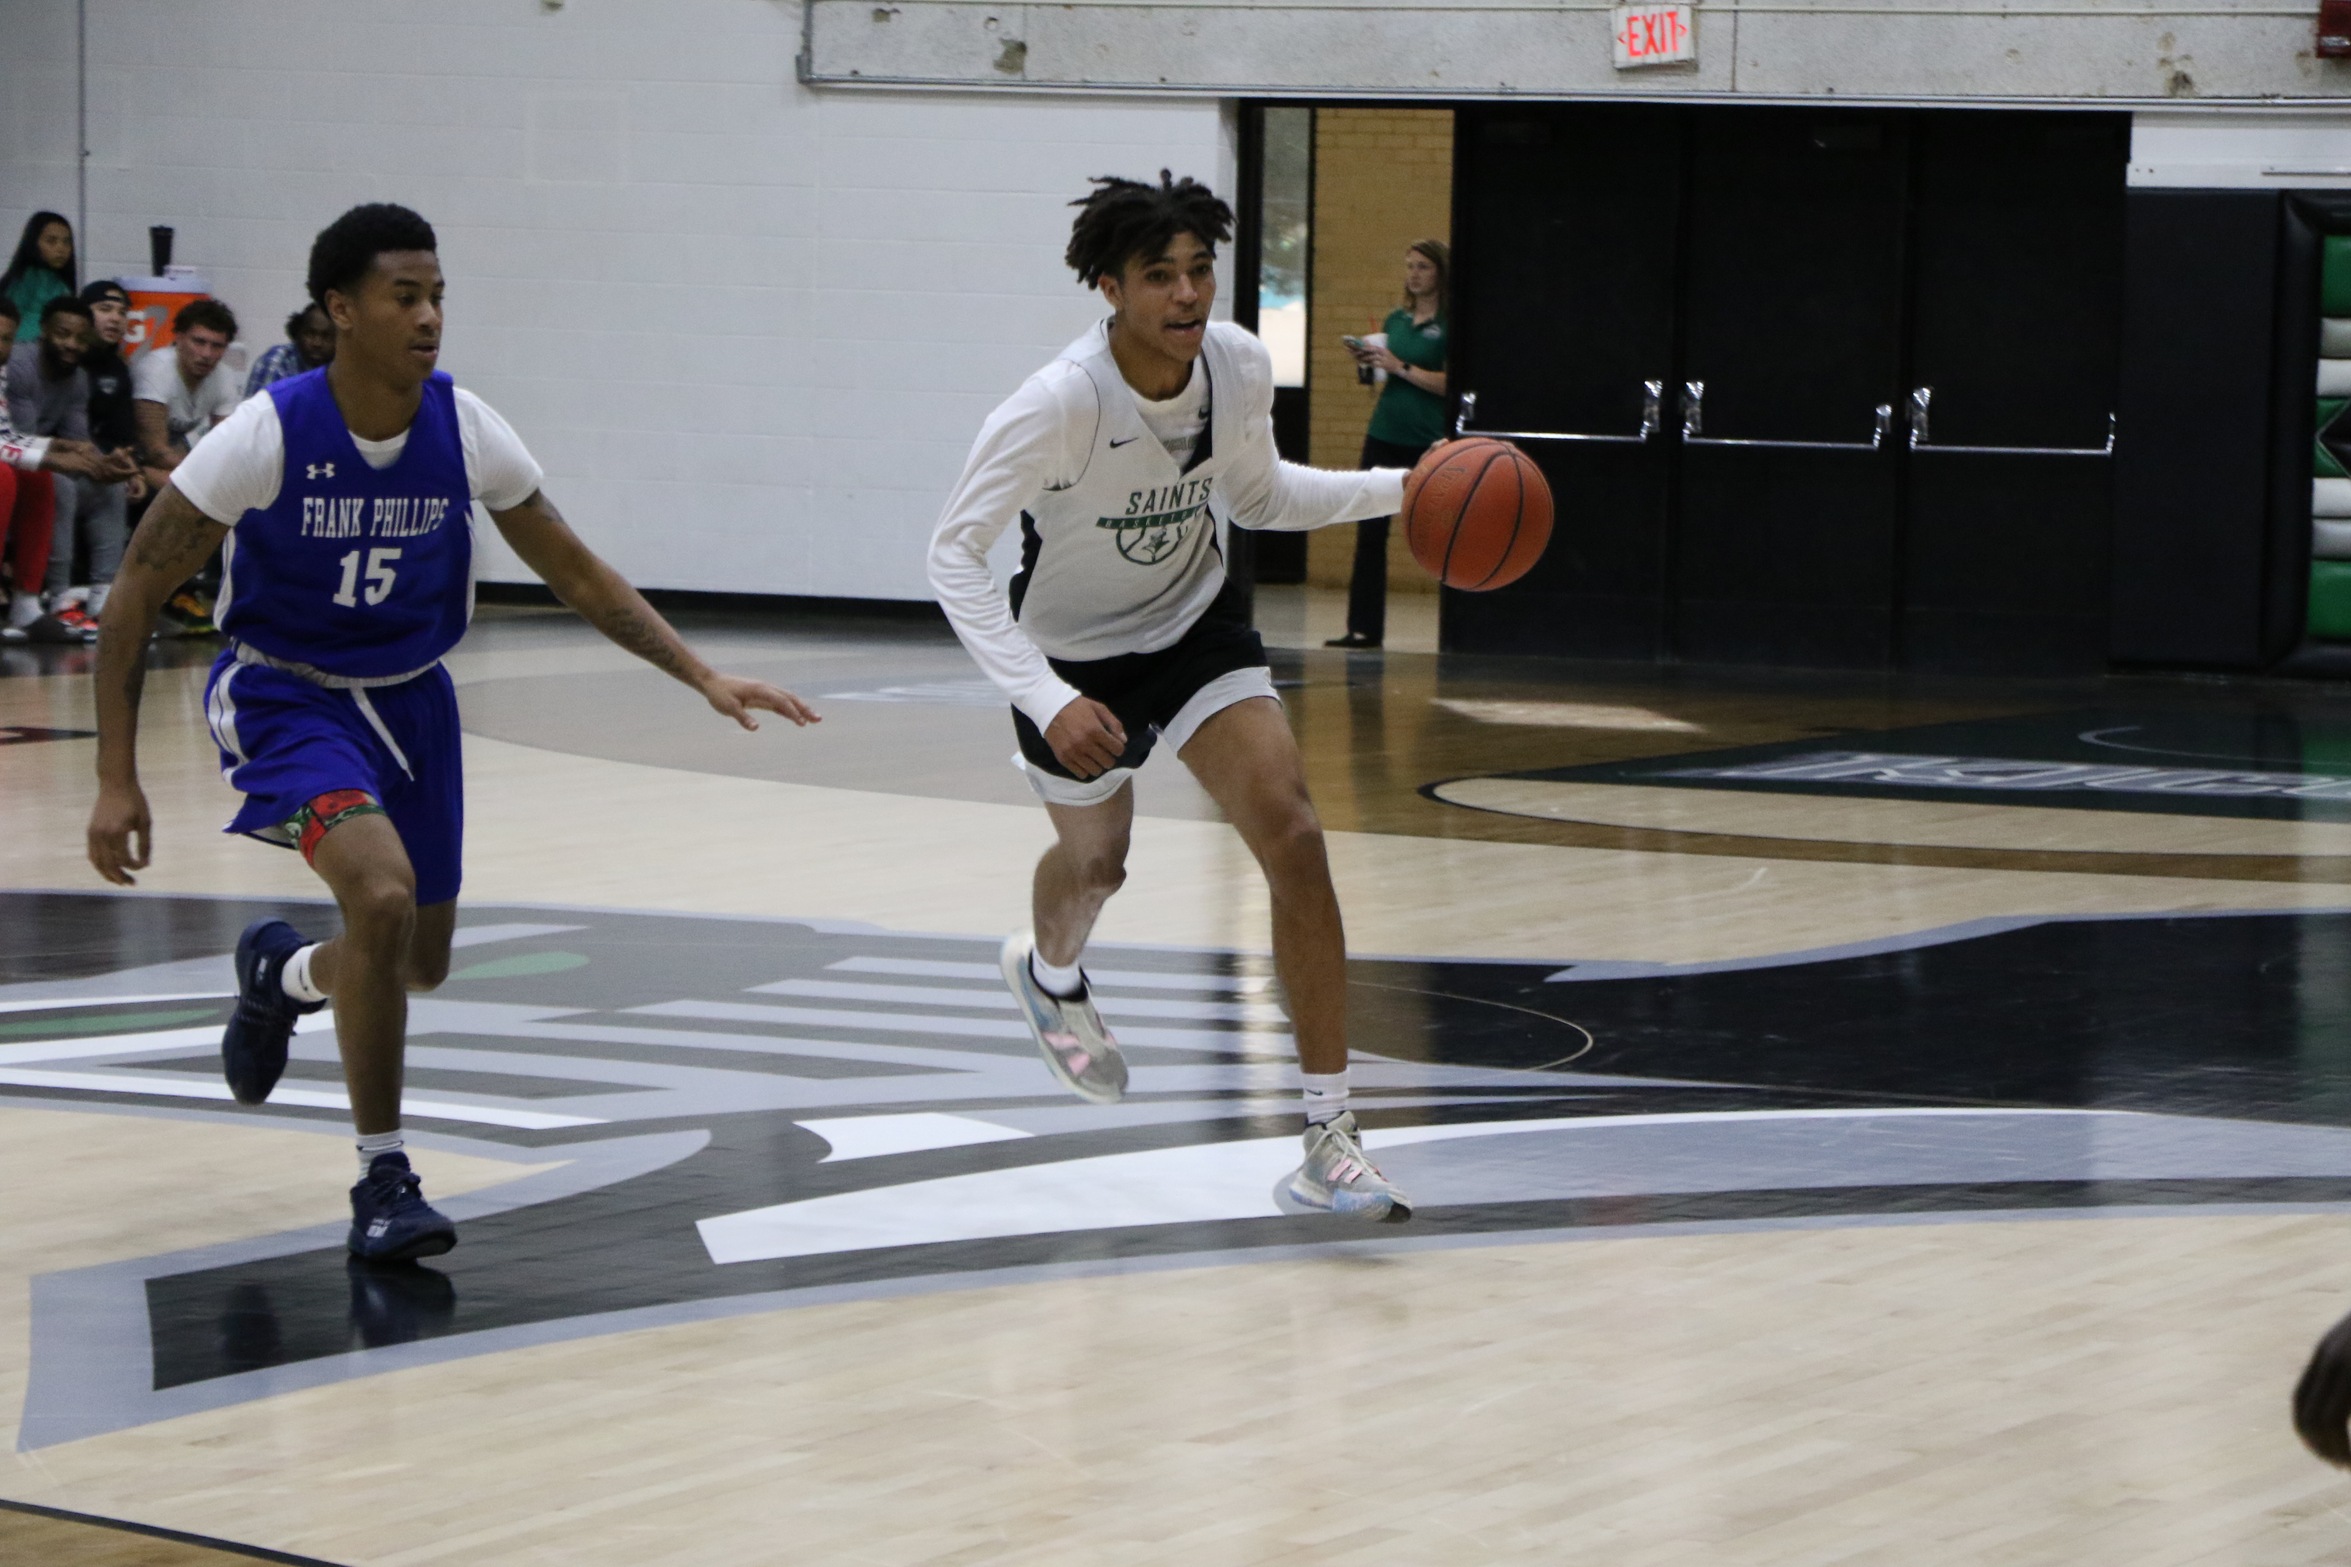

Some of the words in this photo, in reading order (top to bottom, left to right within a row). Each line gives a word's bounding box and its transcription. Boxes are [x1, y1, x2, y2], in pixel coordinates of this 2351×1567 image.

[1626, 11, 1679, 57] EXIT
[124, 310, 146, 342] G
[1125, 477, 1213, 515] SAINTS
[301, 497, 364, 538] FRANK
[369, 498, 449, 537] PHILLIPS
[332, 547, 402, 608] 15
